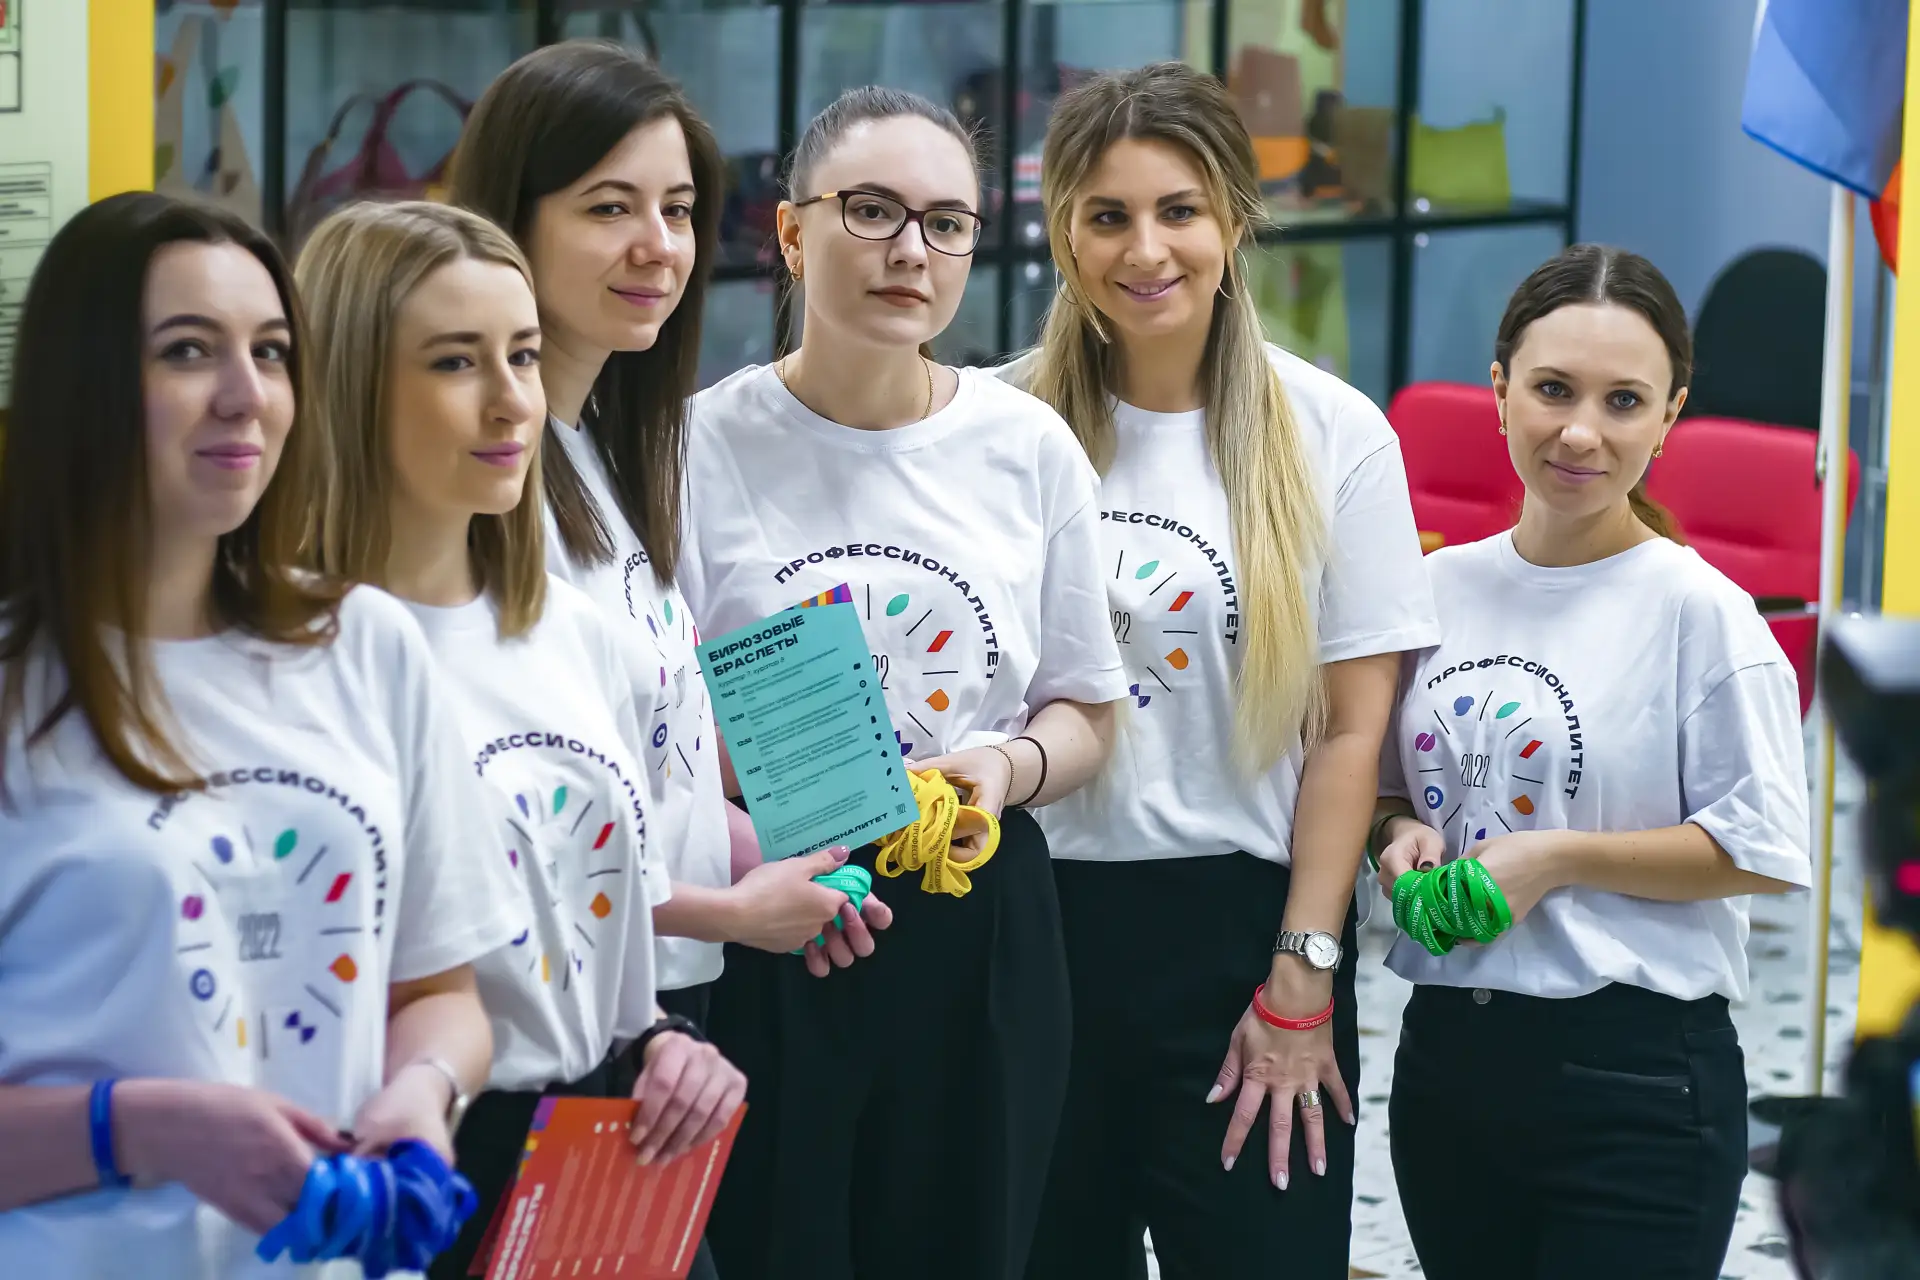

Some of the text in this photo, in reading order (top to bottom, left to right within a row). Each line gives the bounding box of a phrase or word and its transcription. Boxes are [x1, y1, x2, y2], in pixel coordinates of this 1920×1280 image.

[708, 615, 805, 662] БИРЮЗОВЫЕ
[713, 634, 799, 677] БРАСЛЕТЫ
[729, 713, 745, 722] 12:20
[1427, 655, 1583, 800] ПРОФЕССИОНАЛИТЕТ
[746, 766, 762, 775] 13:30
[1461, 753, 1490, 788] 2022
[756, 792, 771, 802] 14:05
